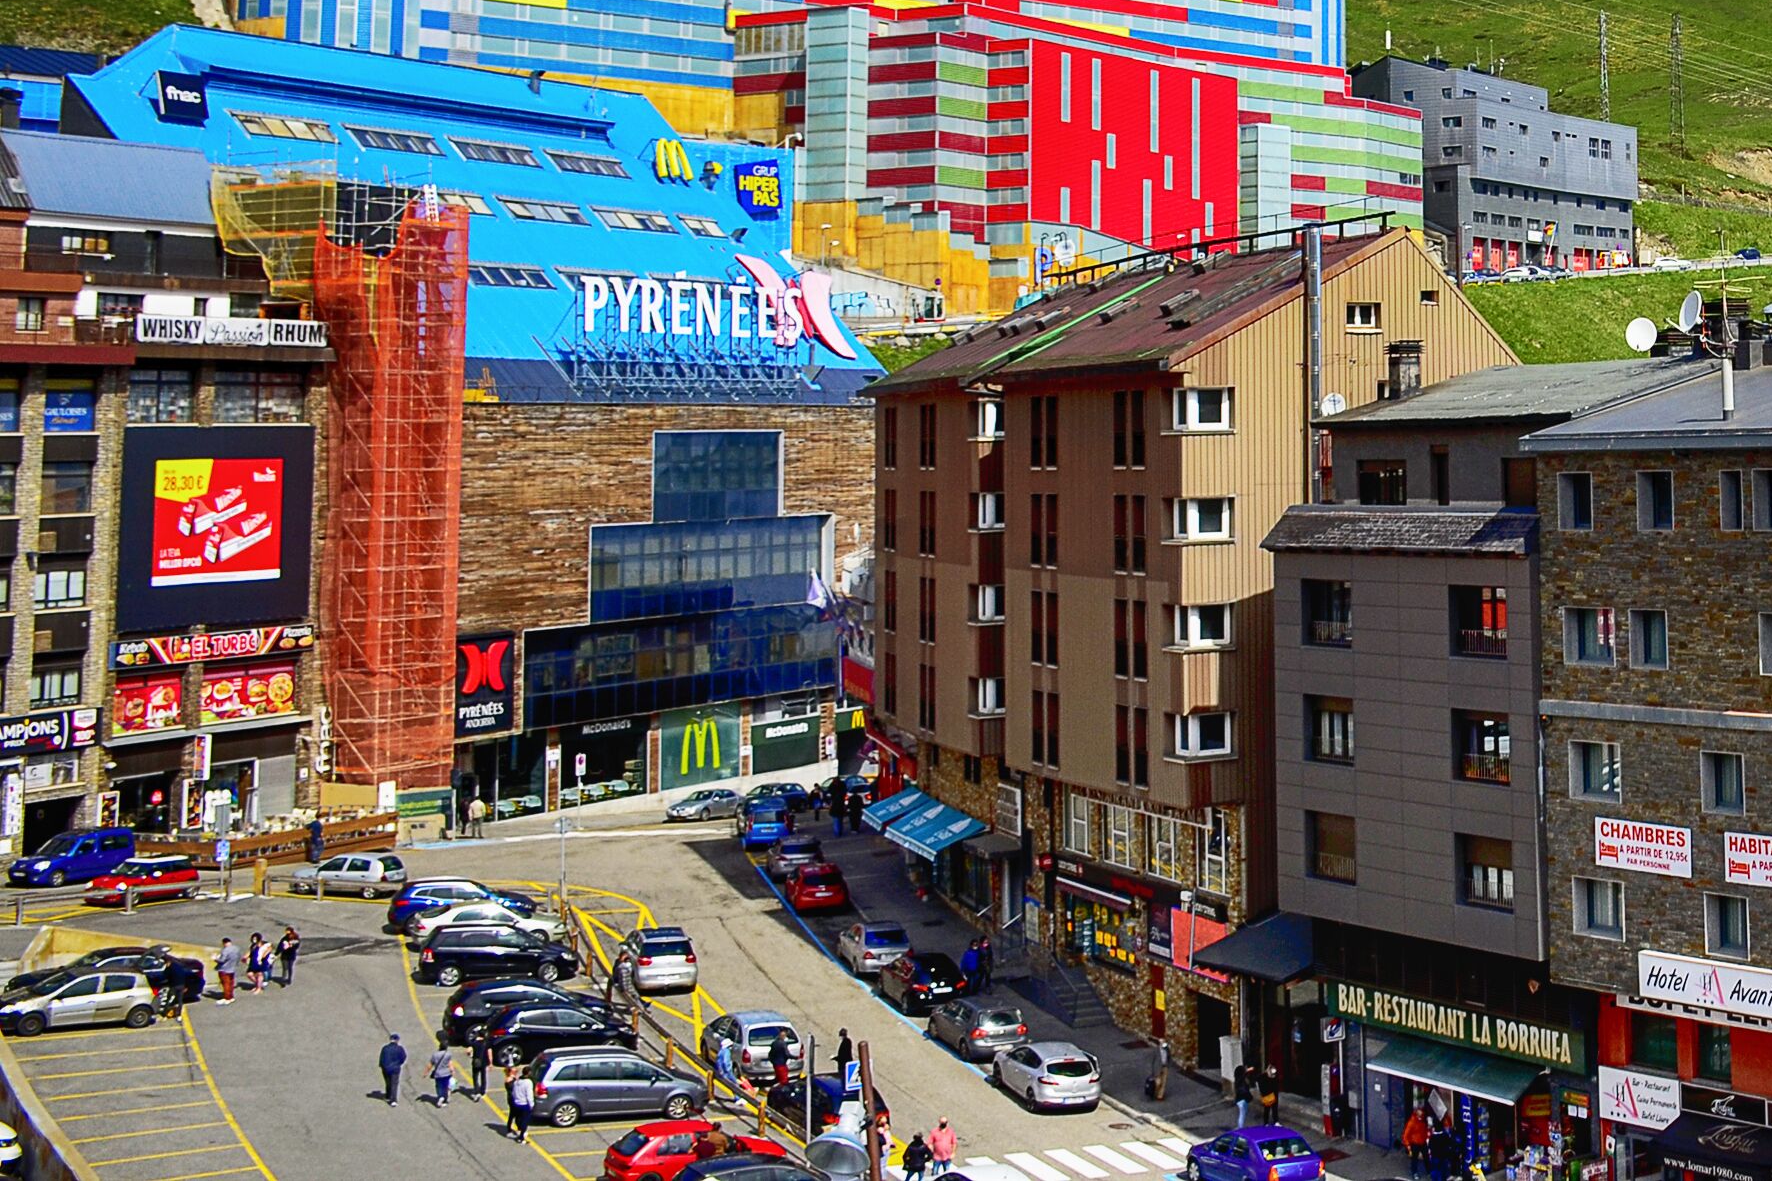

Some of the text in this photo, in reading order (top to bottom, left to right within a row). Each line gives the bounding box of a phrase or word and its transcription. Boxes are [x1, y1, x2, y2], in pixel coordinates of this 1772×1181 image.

[165, 85, 202, 104] fnac
[752, 165, 778, 177] GRUP
[739, 175, 779, 193] HIPER
[752, 190, 780, 208] PAS
[580, 269, 802, 342] PYRÉNÉES
[142, 319, 323, 344] WHISKY Passion RHUM
[163, 476, 195, 493] 28,30
[192, 631, 259, 657] EL TURBO
[459, 702, 505, 720] PYRÉNÉES
[465, 716, 496, 729] ANDORRA
[582, 719, 632, 735] McDonald's
[765, 722, 809, 739] McDonald's
[314, 705, 332, 775] fnac
[1600, 821, 1686, 848] CHAMBRES
[1619, 845, 1689, 864] A PARTIR DE 12,95€
[1639, 861, 1671, 871] PERSONNE
[1751, 860, 1758, 870] A
[1646, 965, 1690, 993] Hotel
[1471, 1013, 1492, 1047] LA
[1496, 1018, 1572, 1065] BORRUFA
[1663, 1156, 1754, 1181] www.lomar1980.com
